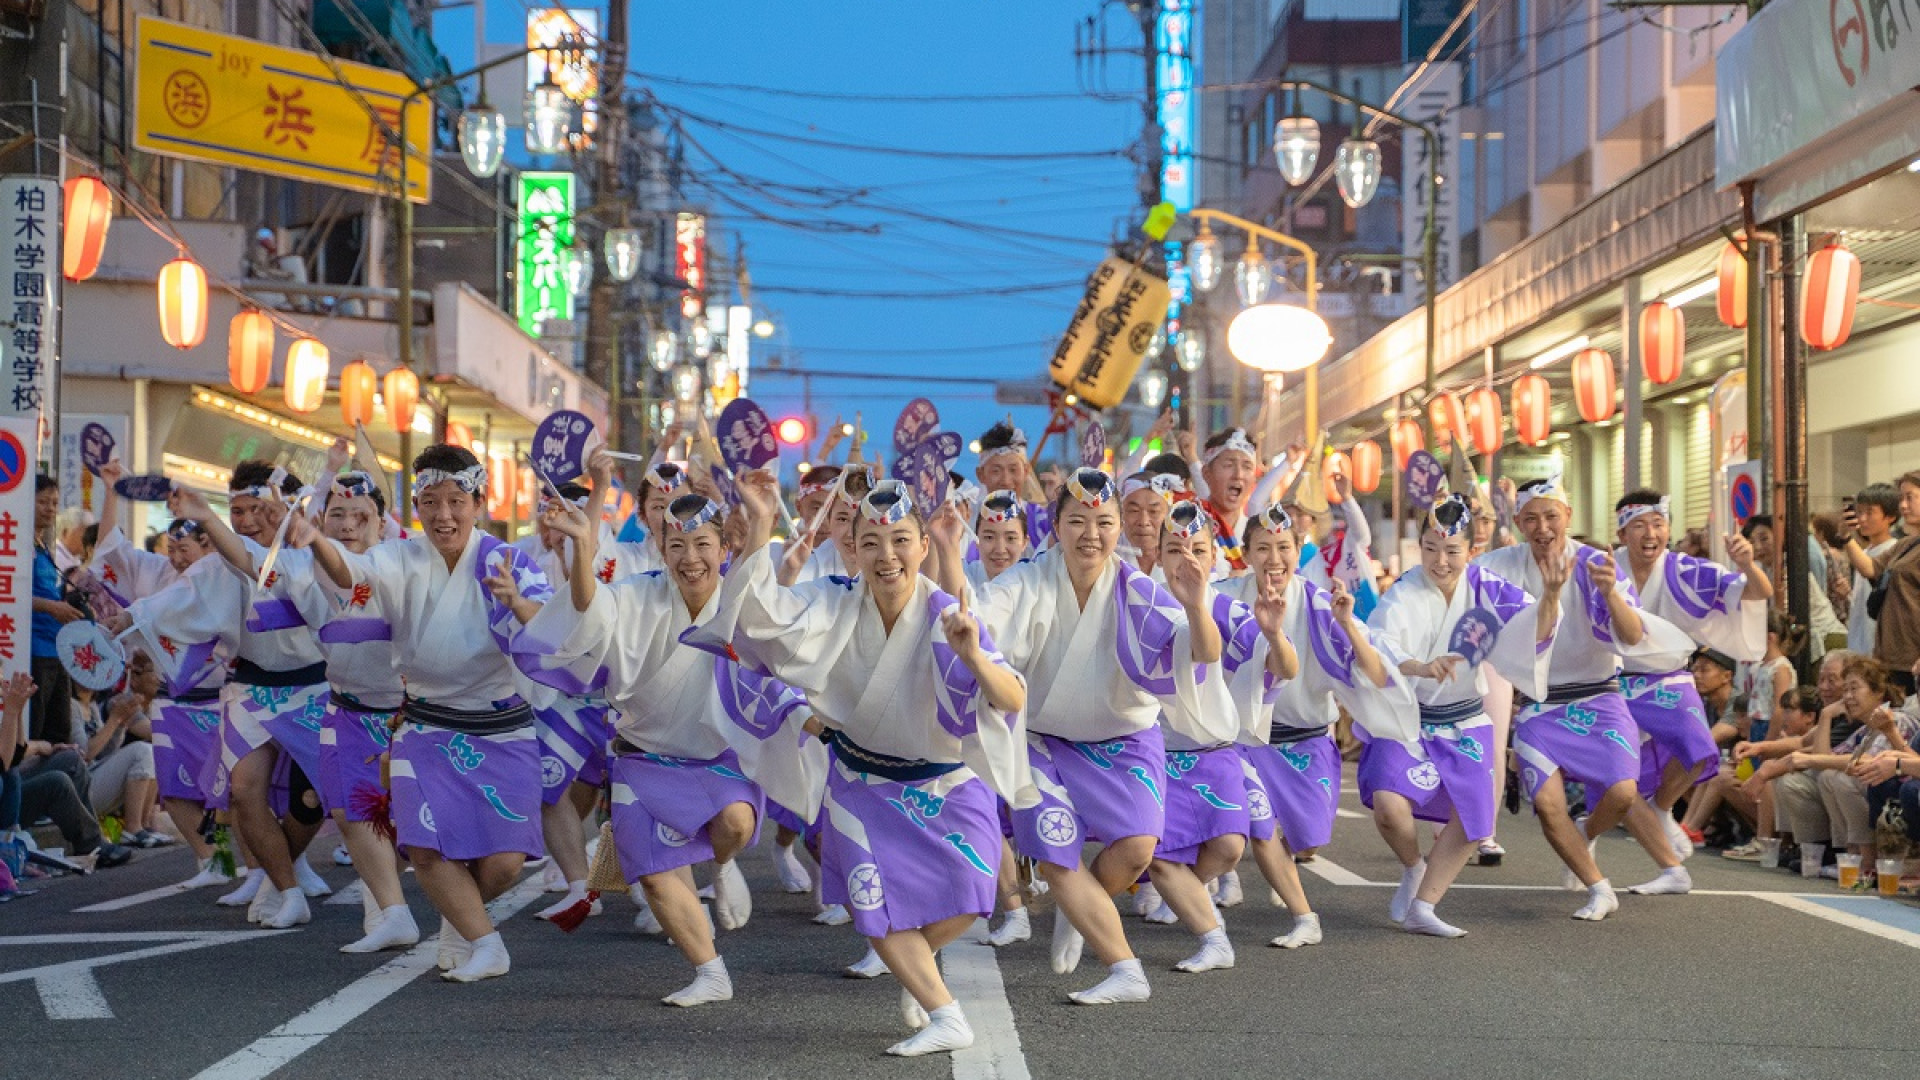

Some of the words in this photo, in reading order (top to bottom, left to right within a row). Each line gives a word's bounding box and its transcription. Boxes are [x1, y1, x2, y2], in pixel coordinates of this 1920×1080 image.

[217, 44, 254, 78] joy
[168, 75, 207, 123] 浜
[11, 186, 46, 411] 柏木学園高等学校
